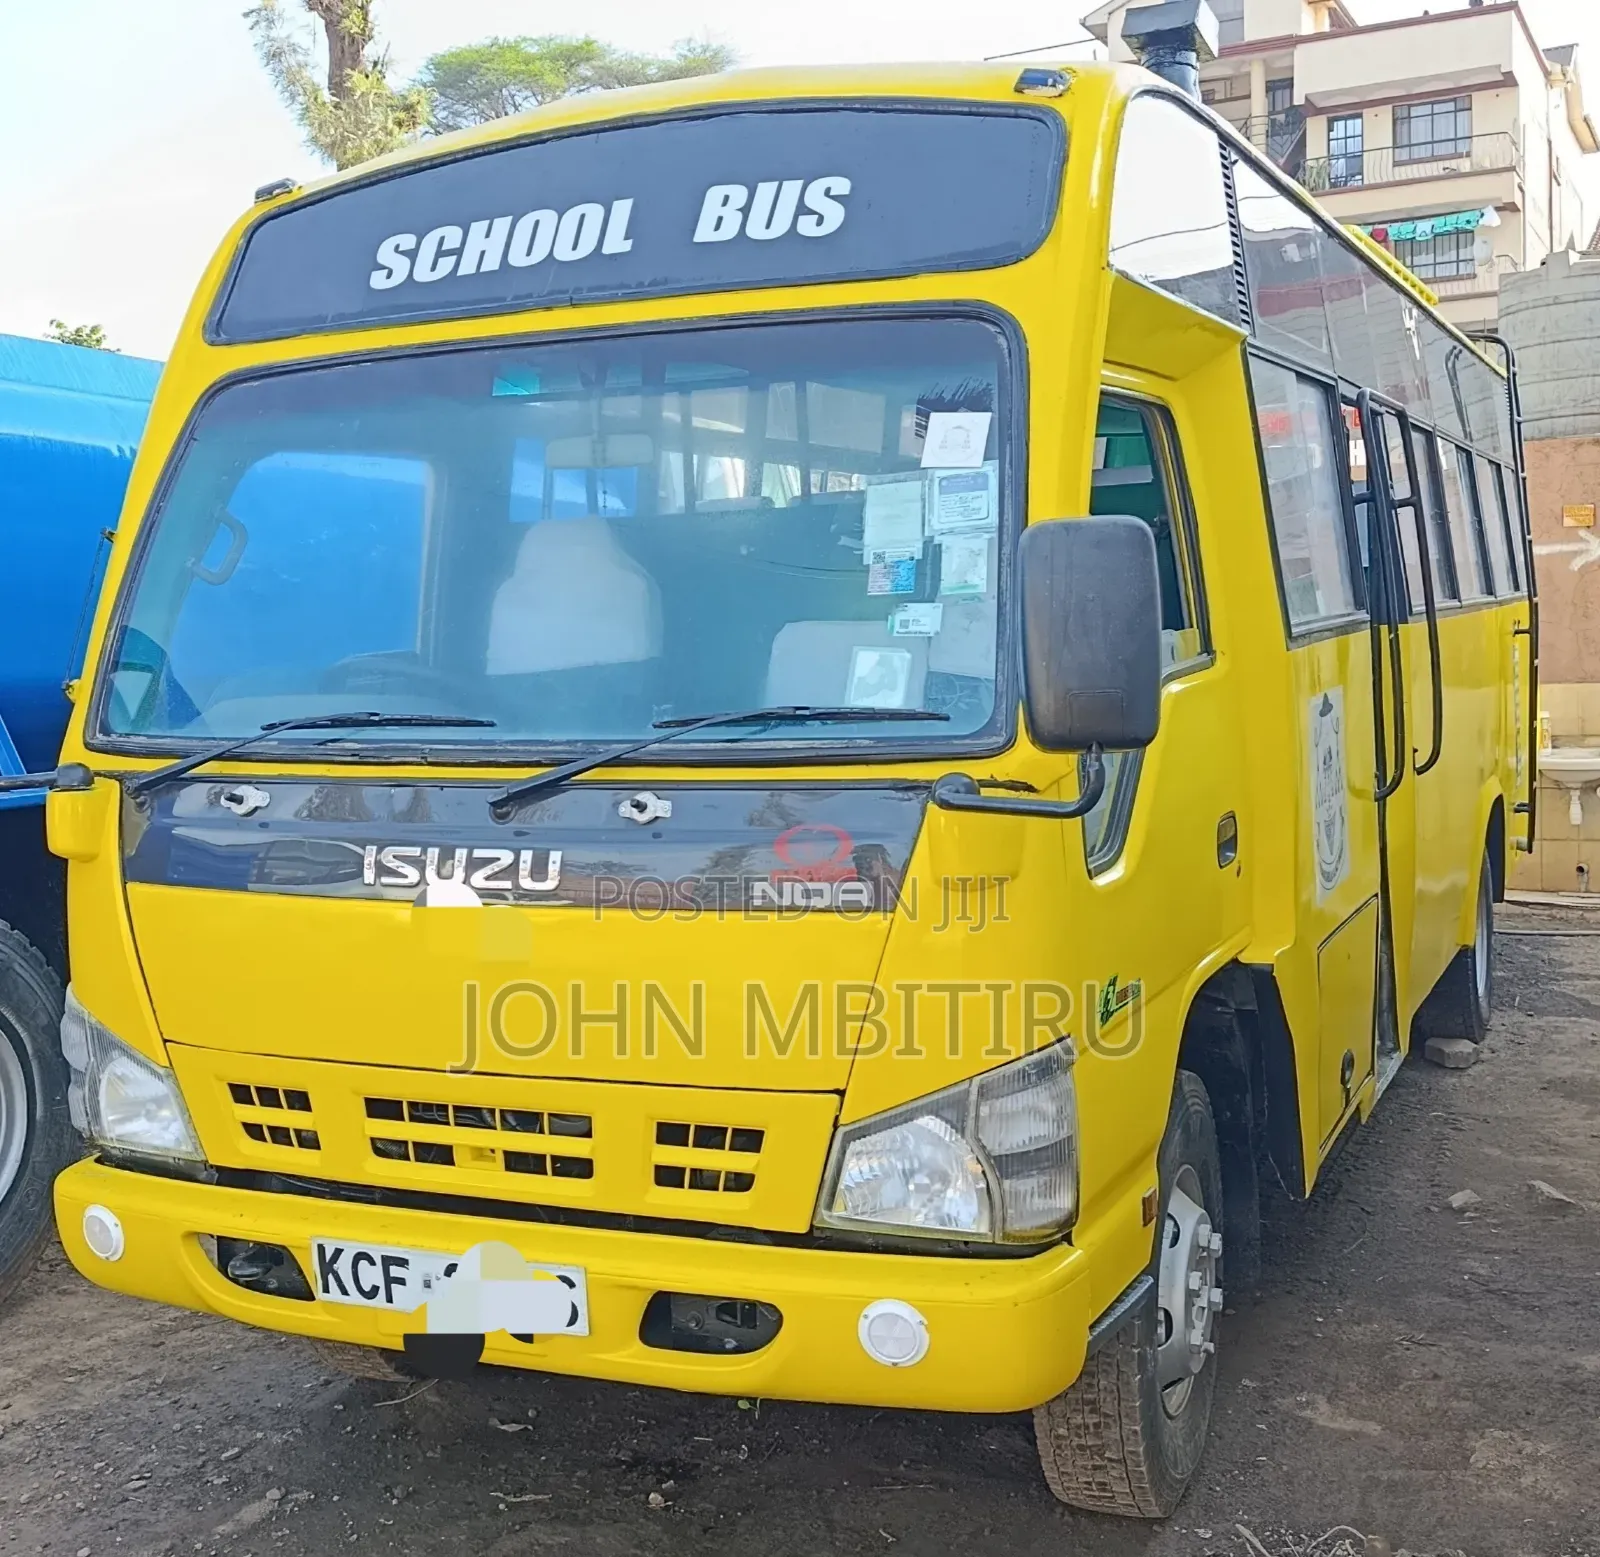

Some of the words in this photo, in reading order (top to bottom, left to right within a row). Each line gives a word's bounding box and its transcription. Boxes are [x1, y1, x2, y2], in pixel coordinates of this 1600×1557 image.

[369, 198, 634, 290] SCHOOL
[693, 176, 852, 243] BUS
[363, 845, 563, 891] ISUZU
[316, 1242, 410, 1304] KCF
